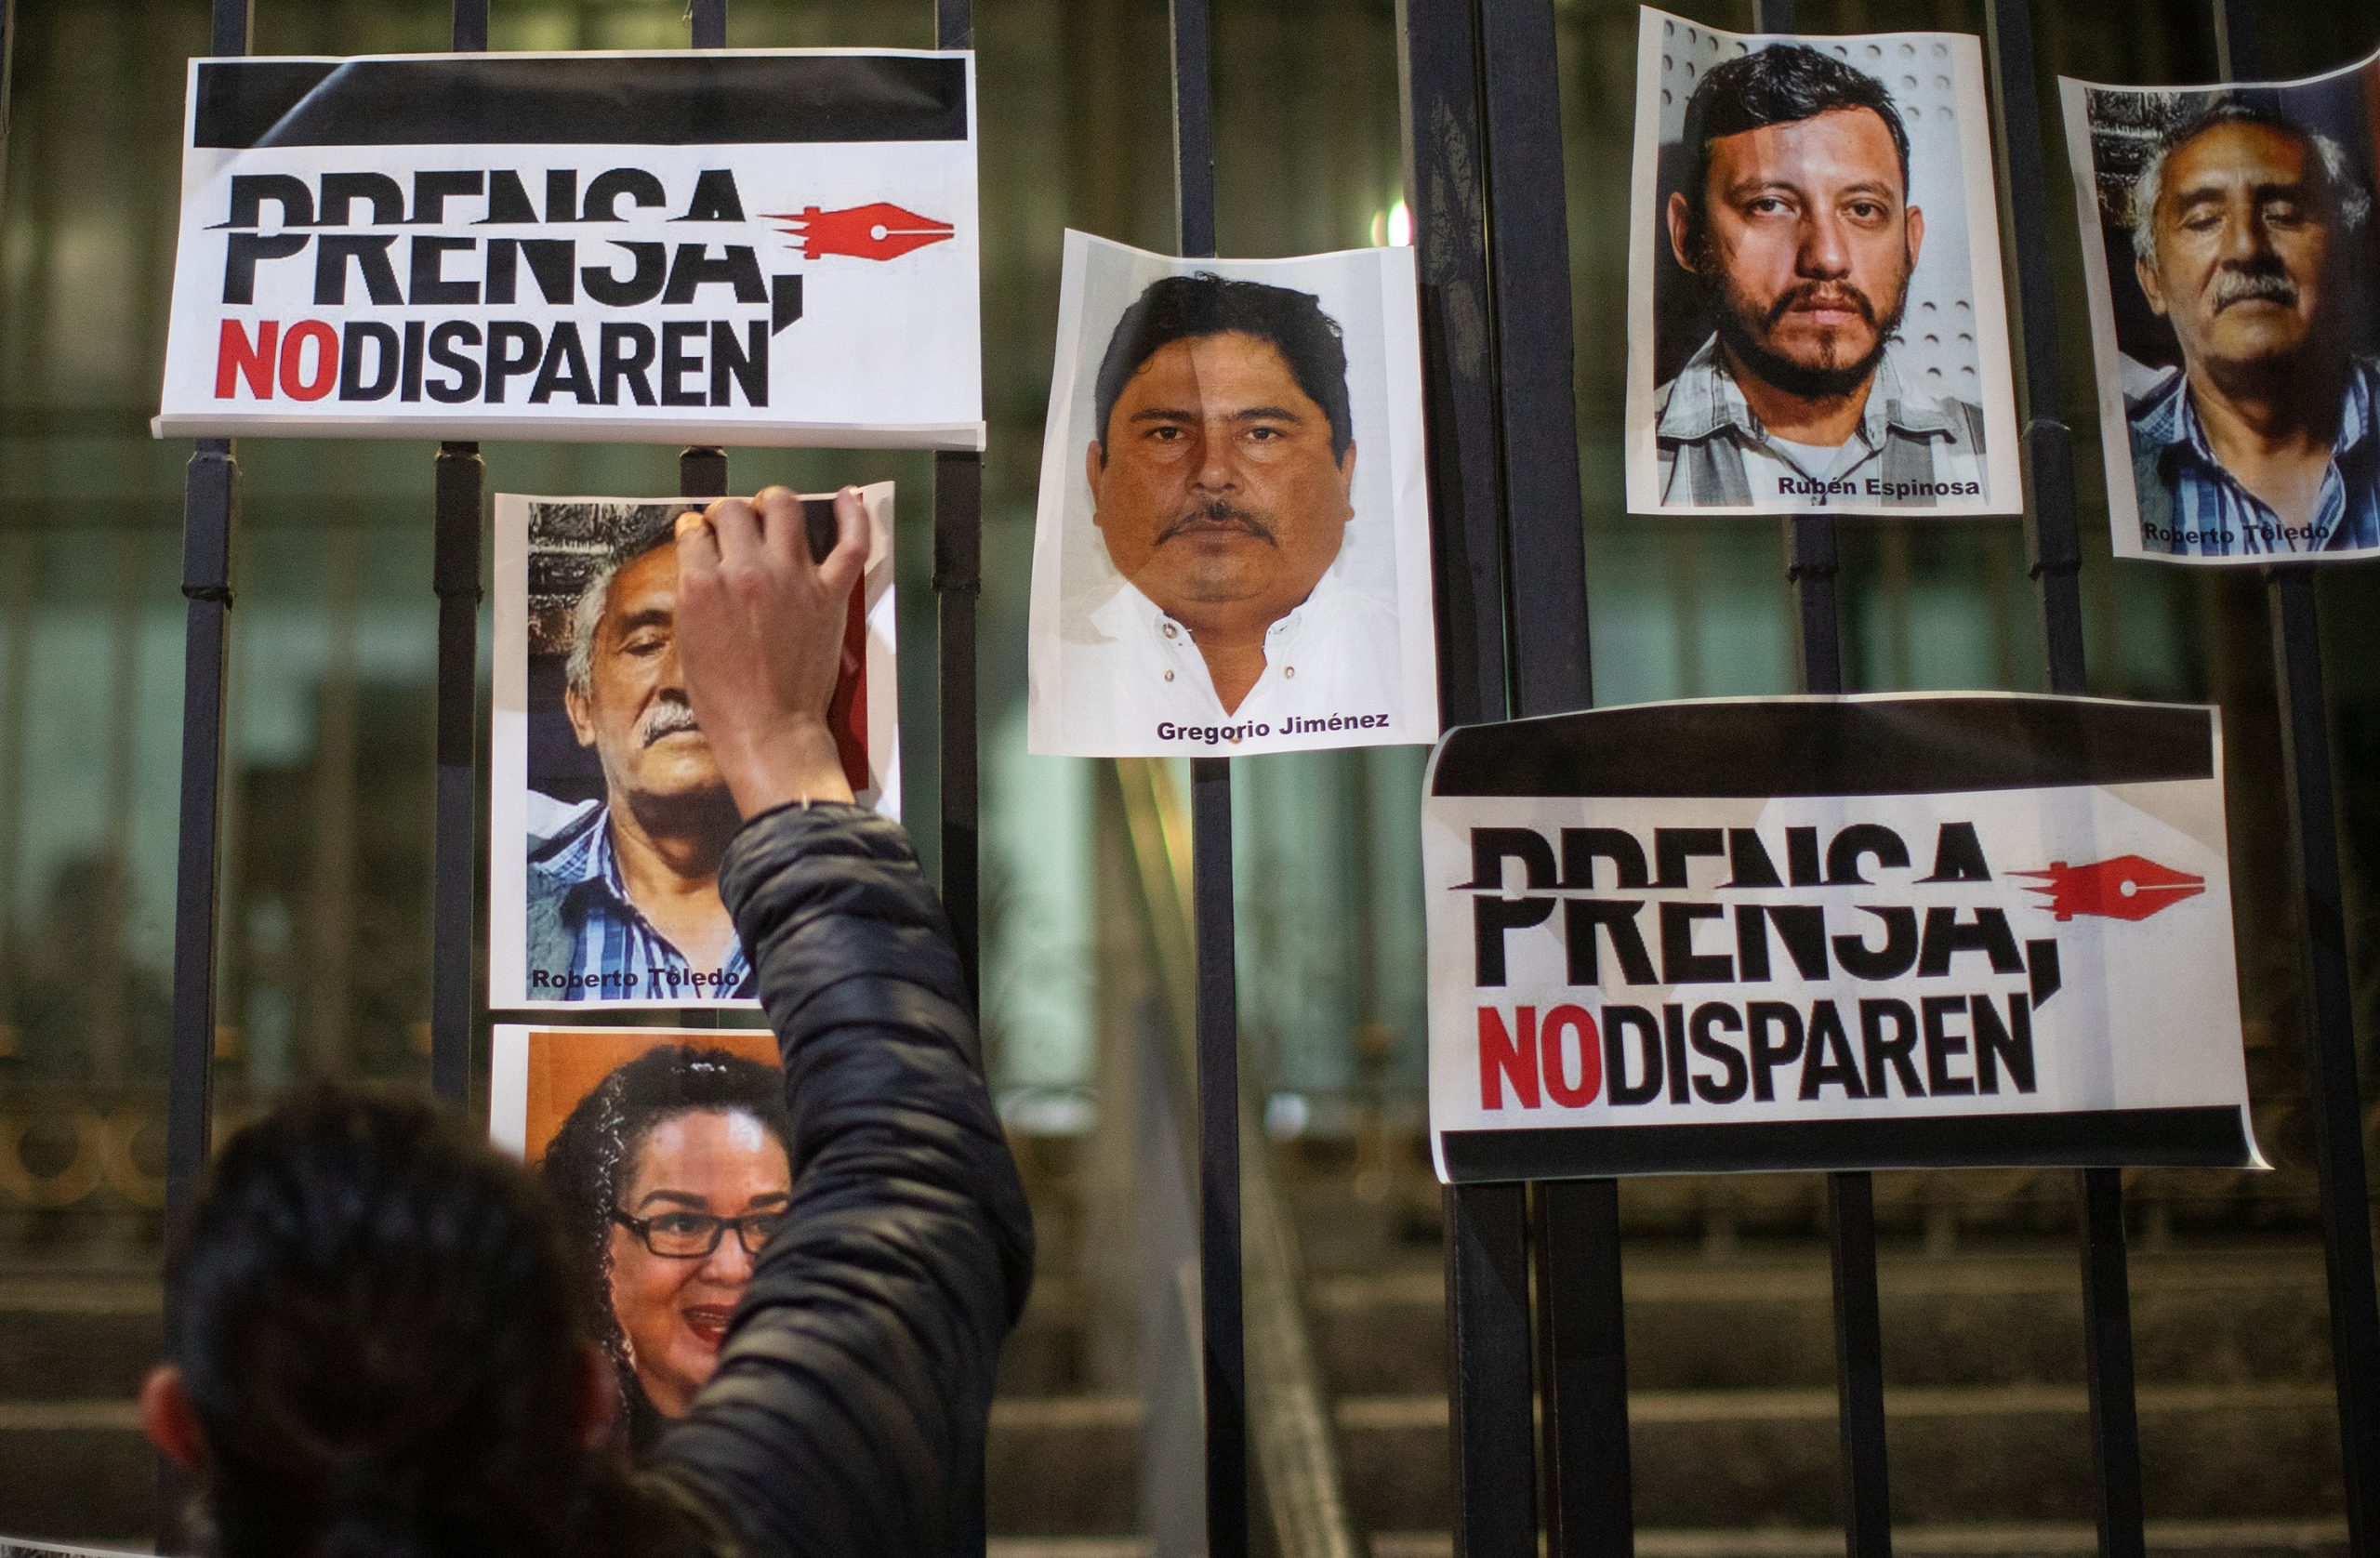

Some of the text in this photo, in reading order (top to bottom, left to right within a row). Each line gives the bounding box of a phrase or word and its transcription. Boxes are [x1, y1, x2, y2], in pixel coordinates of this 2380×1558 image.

[1778, 477, 1980, 500] Rubén Espinosa
[2143, 522, 2330, 545] Roberto Toledo
[1157, 712, 1390, 746] Gregorio Jiménez
[532, 967, 740, 989] Roberto Toledo
